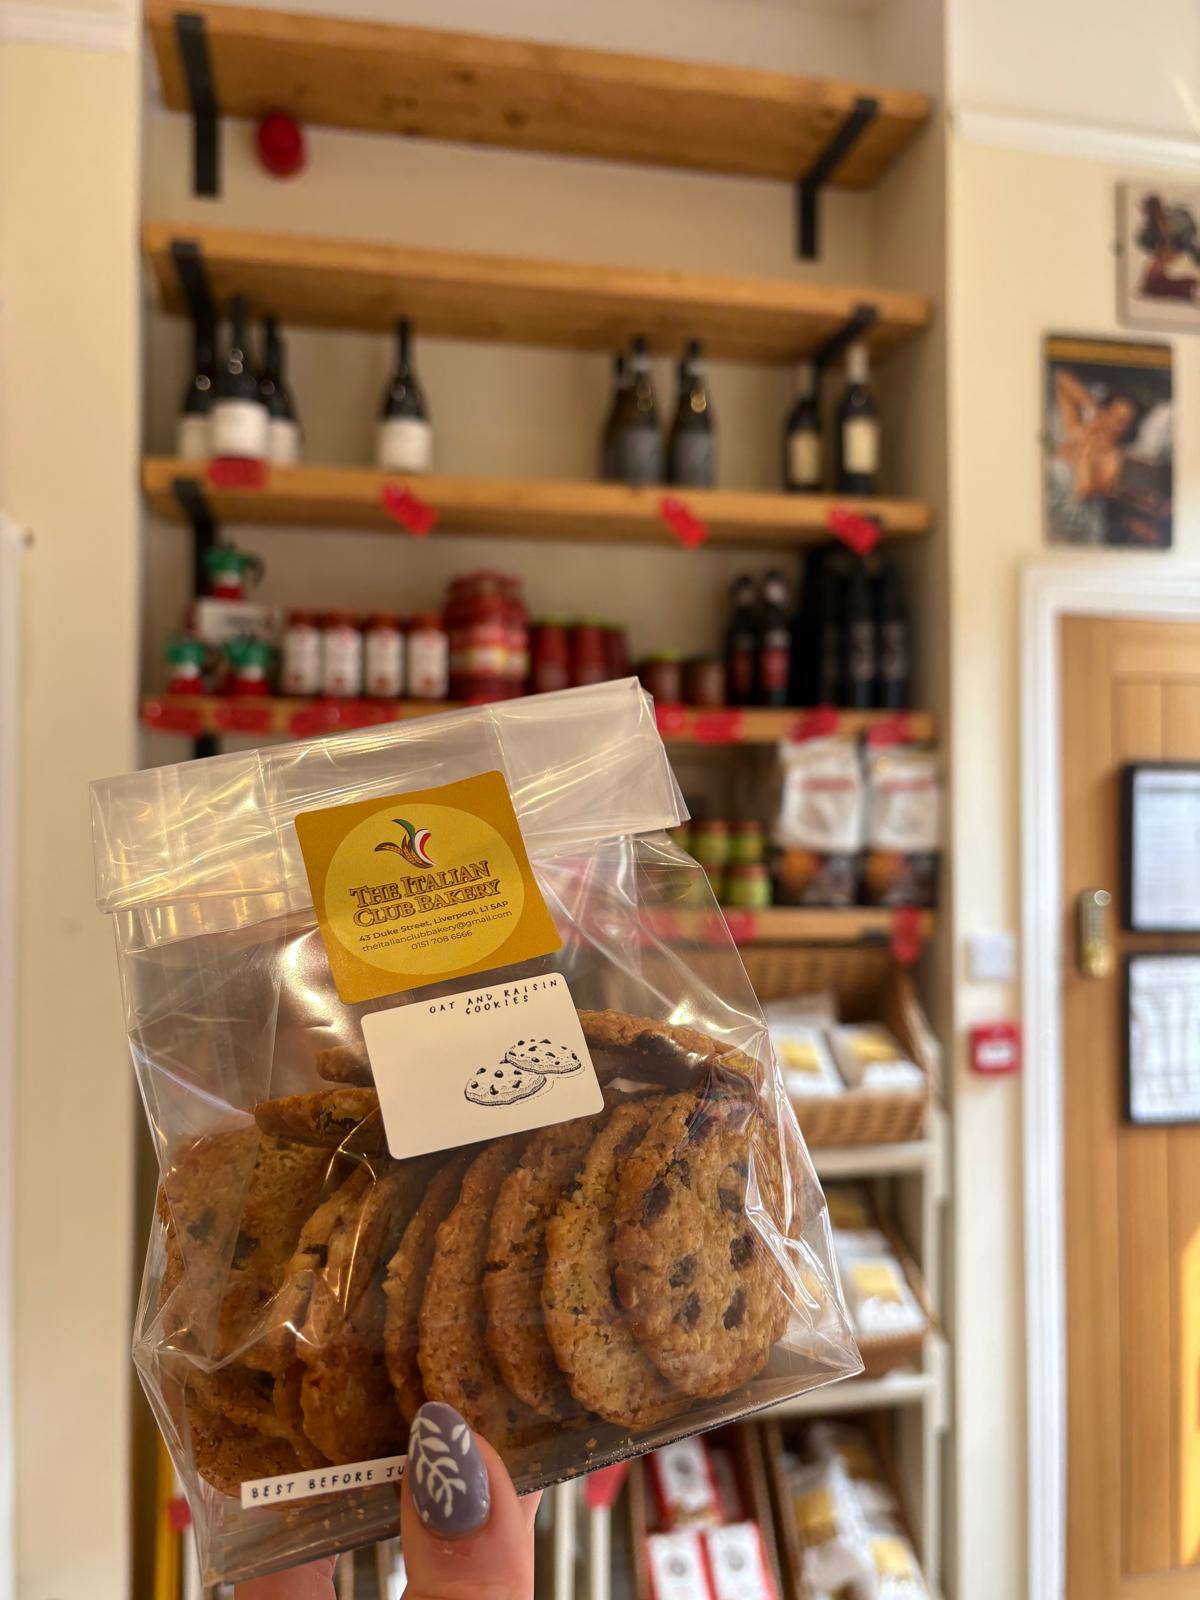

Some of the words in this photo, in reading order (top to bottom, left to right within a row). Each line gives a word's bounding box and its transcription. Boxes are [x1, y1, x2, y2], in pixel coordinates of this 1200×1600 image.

[359, 934, 371, 942] 43
[373, 928, 399, 939] Duke
[400, 920, 433, 933] Street,
[434, 908, 479, 924] Liverpool,
[480, 905, 489, 913] L1
[490, 900, 508, 910] 5AP
[362, 910, 512, 952] theitalianclubbakery@gmail.com
[411, 940, 430, 950] 0151
[431, 935, 450, 946] 708
[450, 930, 473, 941] 6566
[429, 1001, 455, 1014] OAT
[467, 994, 493, 1006] AND
[504, 980, 557, 997] RAISIN
[465, 995, 528, 1015] COOKIES
[251, 1481, 295, 1499] BEST
[308, 1469, 374, 1489] BEFORE
[386, 1465, 405, 1478] JU
